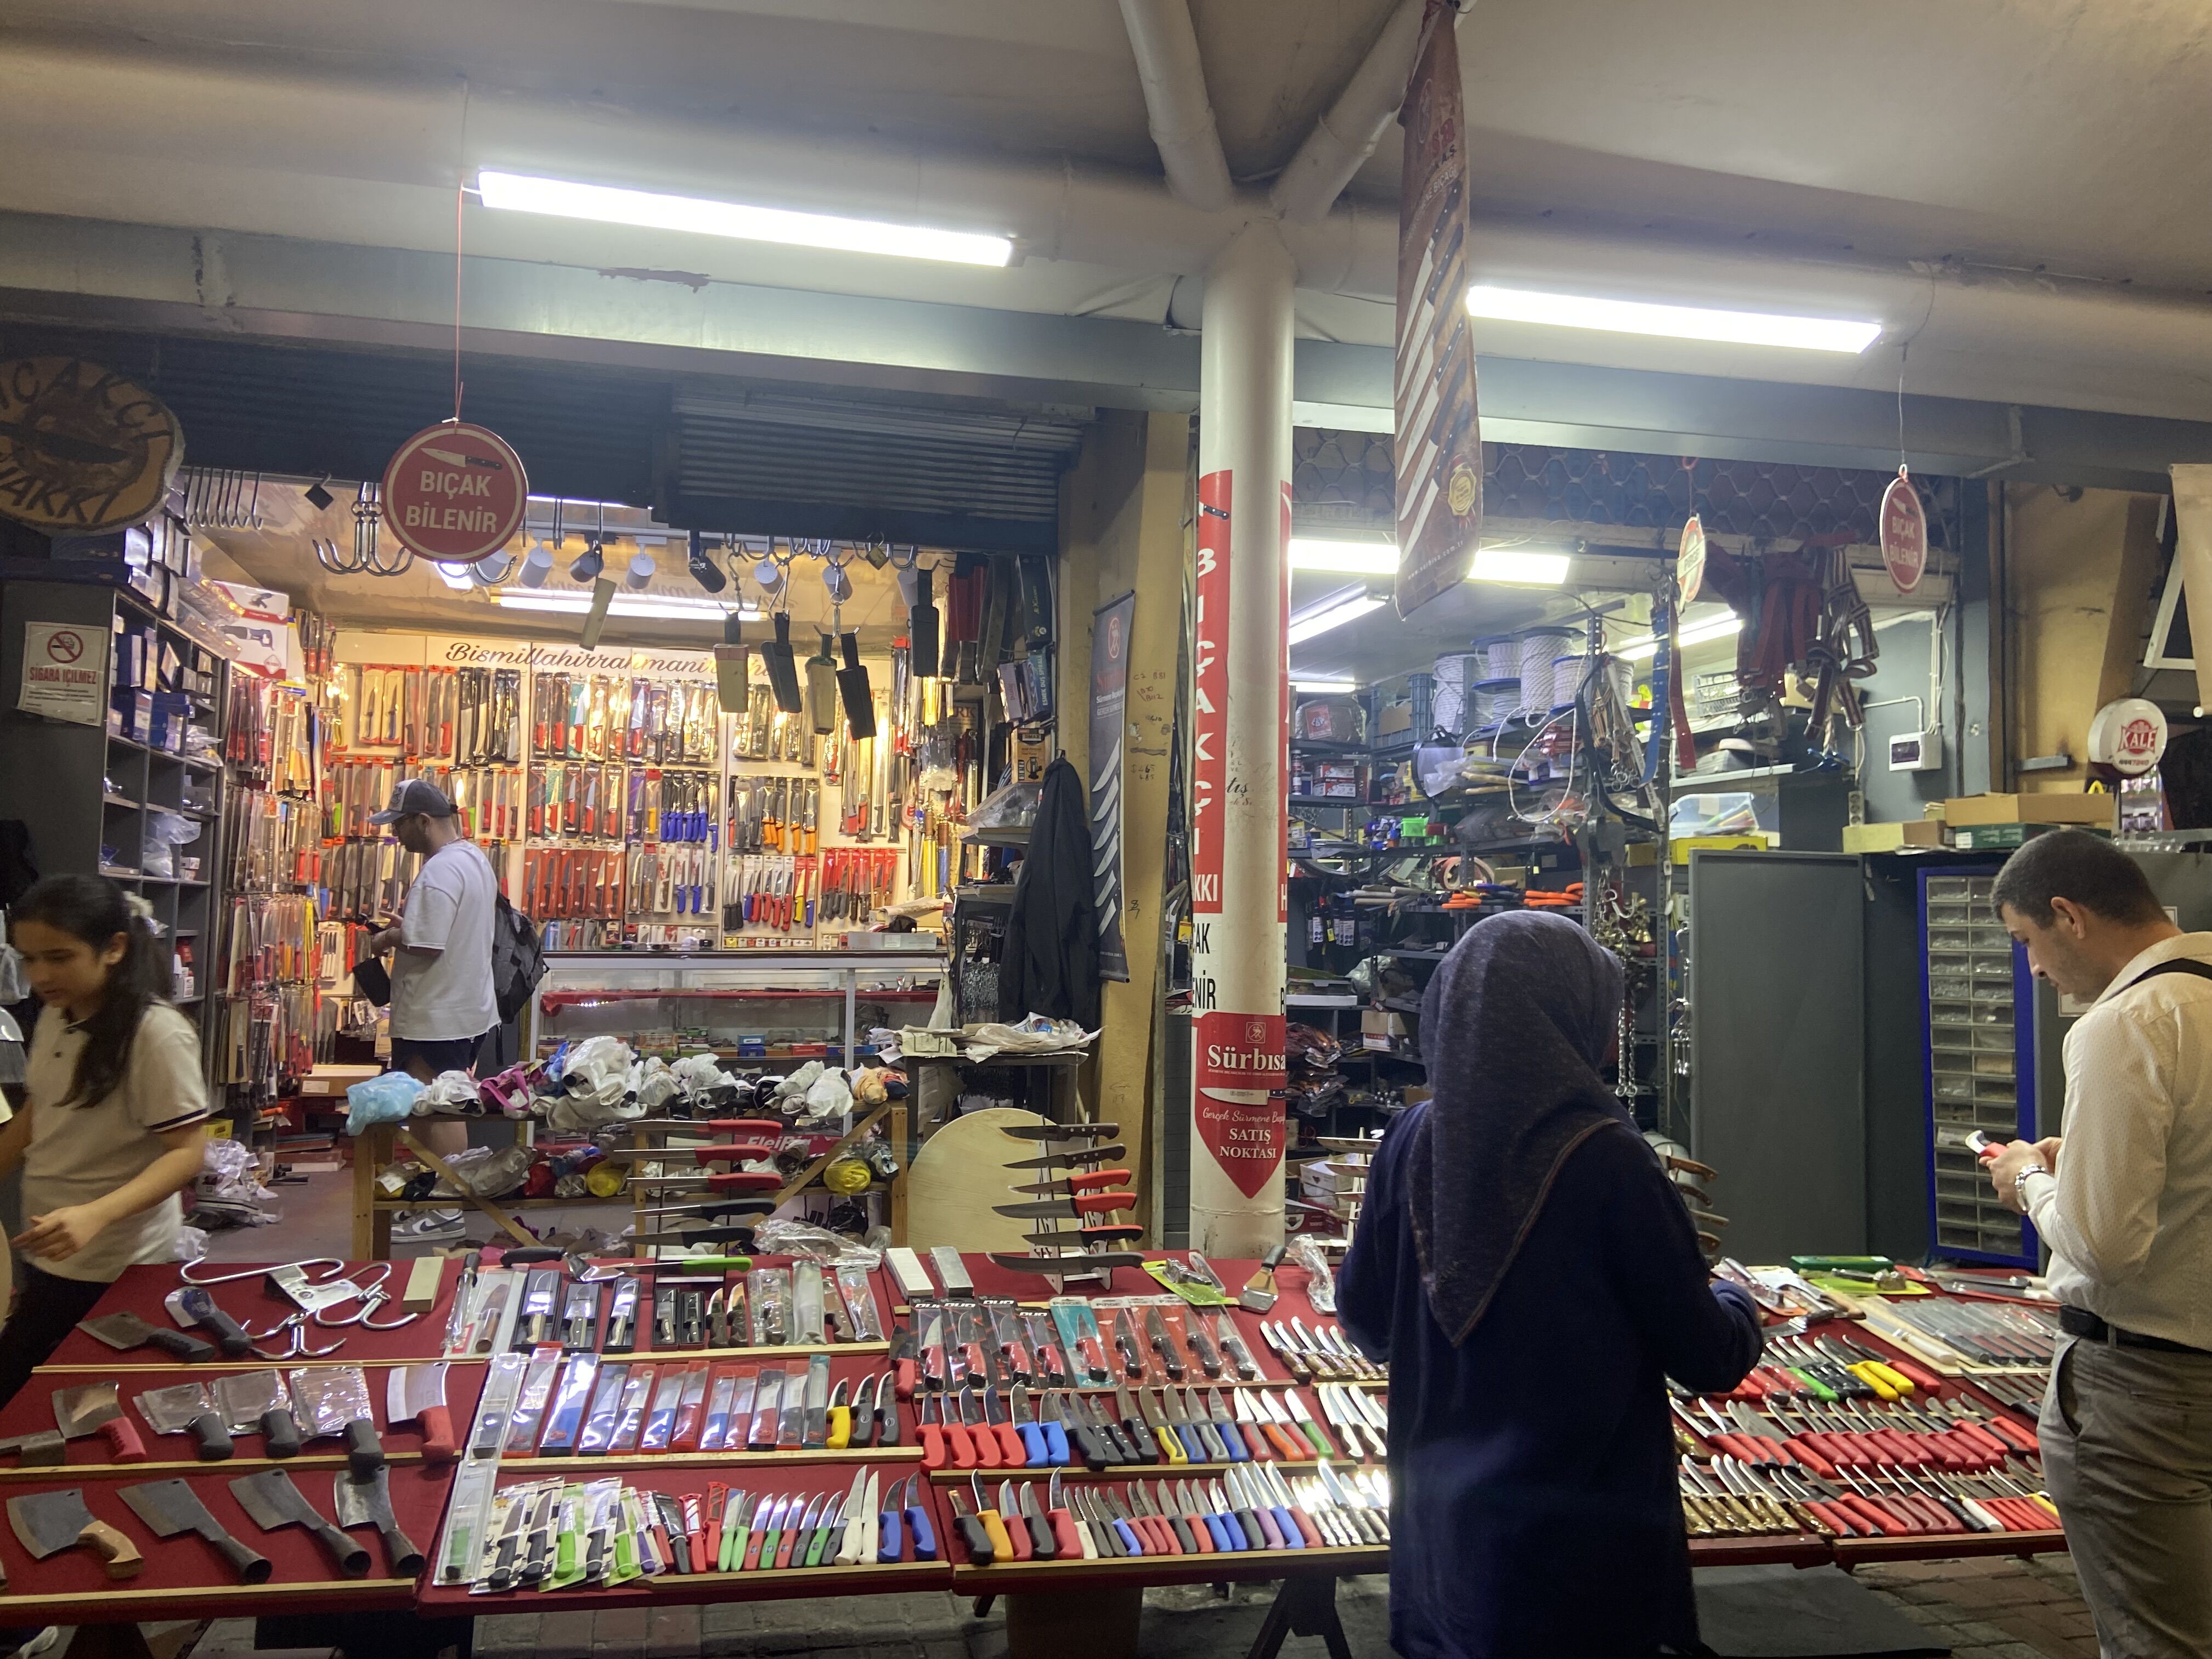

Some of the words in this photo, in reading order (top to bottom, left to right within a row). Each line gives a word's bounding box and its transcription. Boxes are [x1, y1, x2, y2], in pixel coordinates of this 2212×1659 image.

[420, 471, 492, 499] BIÇAK
[405, 505, 497, 534] BİLENİR
[1891, 516, 1915, 540] BIÇAK
[1889, 541, 1919, 569] BİLENİR
[2120, 729, 2157, 750] KALE
[1194, 874, 1218, 902] KKI
[1203, 1107, 1229, 1122] Gerçek
[1232, 1110, 1271, 1123] Sürmene
[1229, 1128, 1271, 1144] SATIŞ
[1220, 1146, 1277, 1159] NOKTASI
